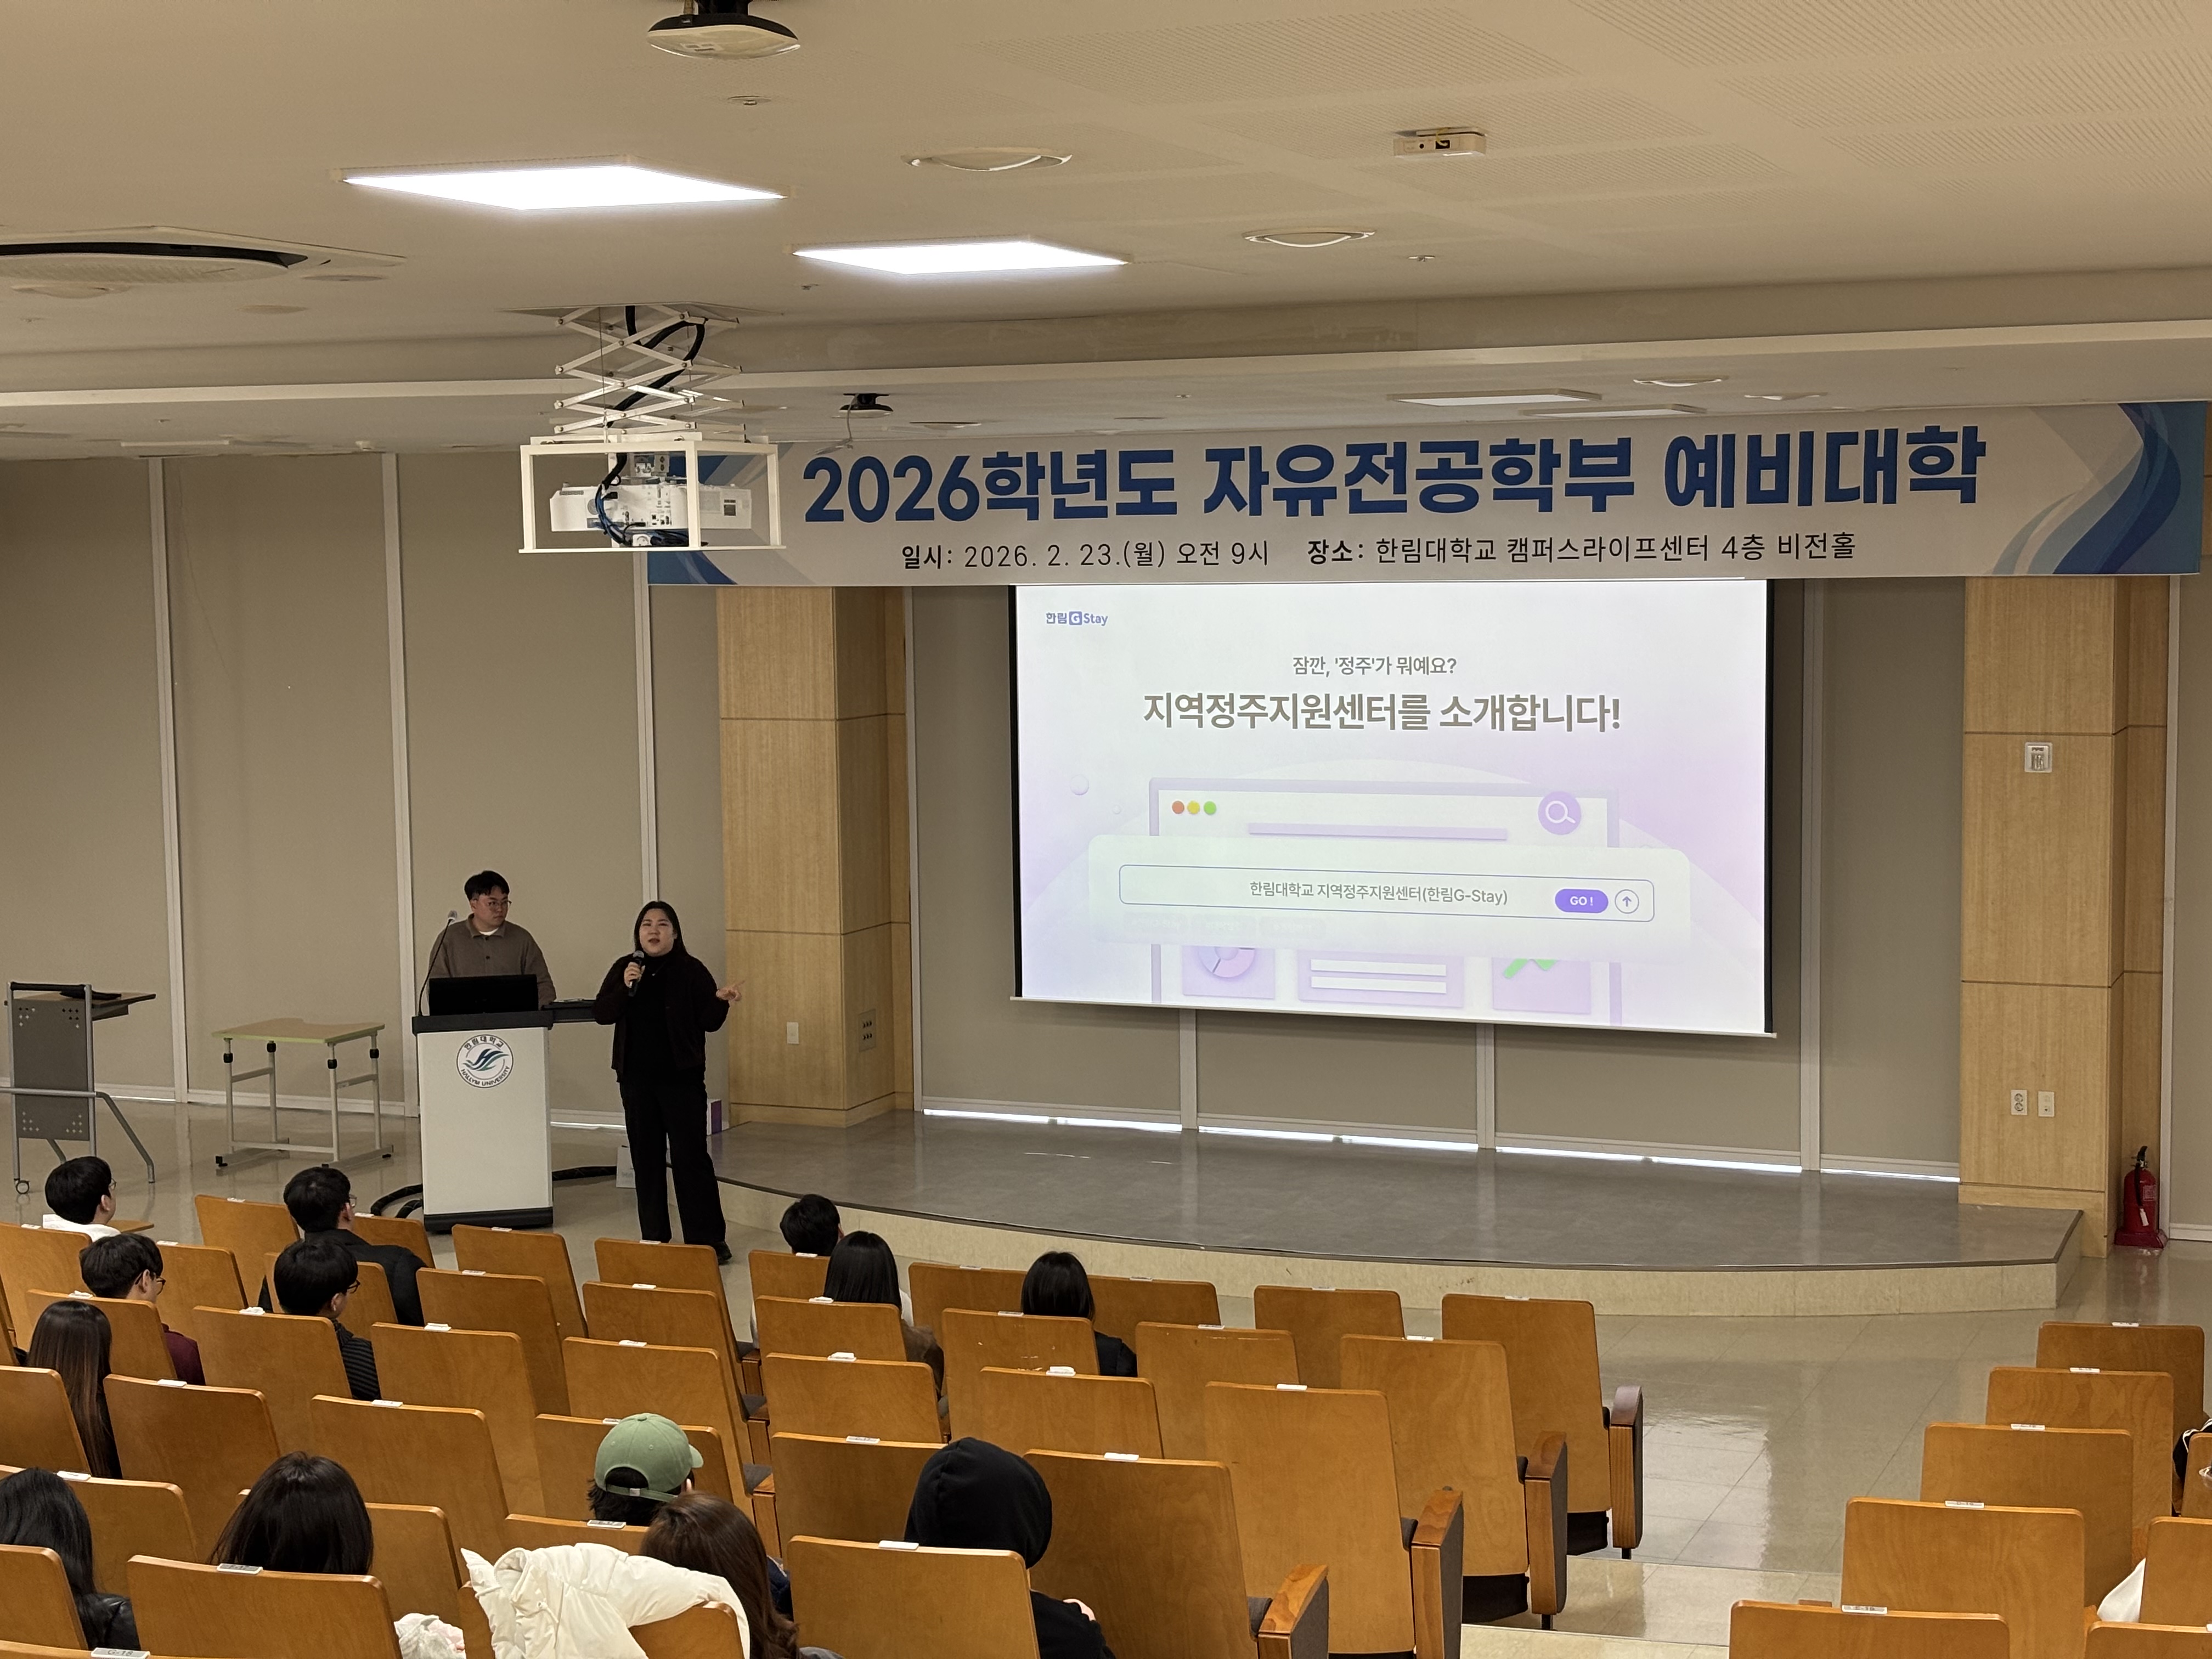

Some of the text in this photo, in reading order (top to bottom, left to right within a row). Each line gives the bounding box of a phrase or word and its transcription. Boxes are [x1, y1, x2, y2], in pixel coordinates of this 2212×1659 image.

[803, 425, 1987, 523] 2026학년도 자유전공학부 예비대학
[902, 531, 1856, 569] 일시: 2026. 2. 23.(월) 오전 9시 장소: 한림대학교 캠퍼스라이프센터 4층 비전홀
[1293, 656, 1457, 678] 잠깐, '정주'가 뭐예요?
[1143, 692, 1620, 733] 지역정주지원센터를 소개합니다!
[1250, 881, 1314, 898] 한림대학교
[464, 1036, 504, 1050] 한림대학교
[461, 1065, 510, 1086] HALLYM UNIVERSITY
